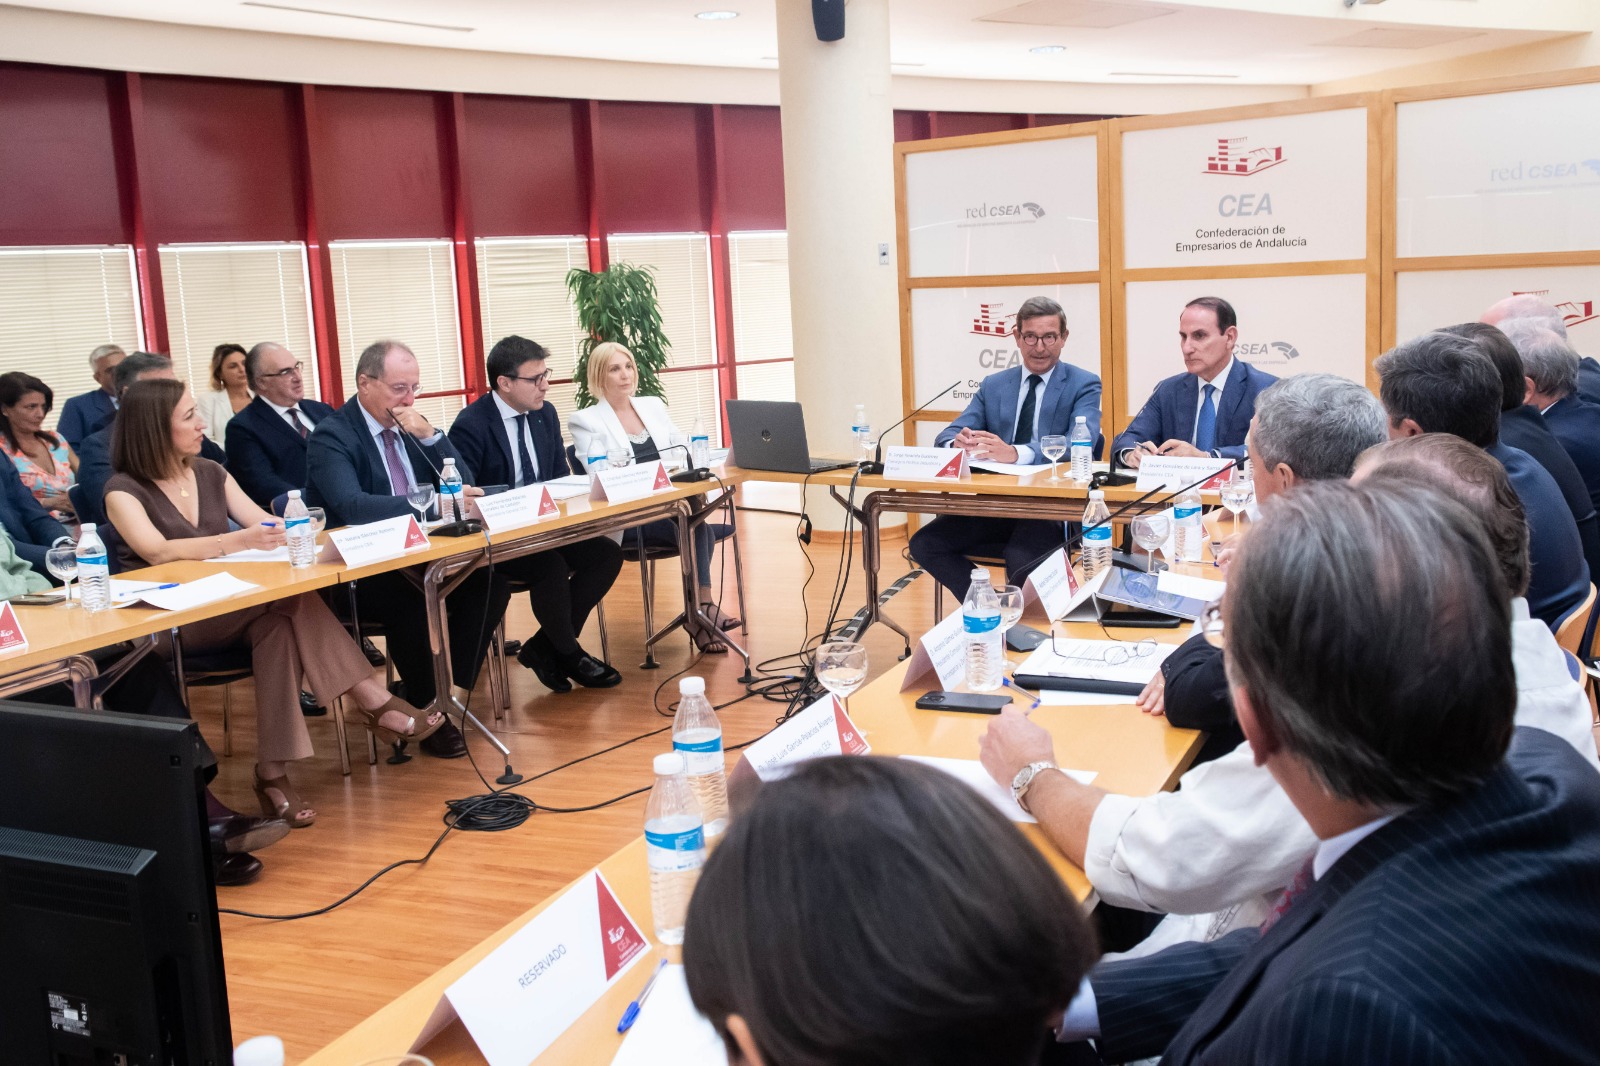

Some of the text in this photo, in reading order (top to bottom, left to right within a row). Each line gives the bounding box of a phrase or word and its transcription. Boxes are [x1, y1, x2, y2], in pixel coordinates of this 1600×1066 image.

[1490, 160, 1577, 181] red CSEA
[966, 203, 1021, 218] red CSEA
[1218, 193, 1273, 217] CEA
[1195, 225, 1285, 239] Confederación de
[1175, 236, 1307, 253] Empresarios de Andalucía
[1233, 343, 1268, 355] CSEA
[979, 349, 1020, 368] CEA
[765, 755, 777, 767] José
[776, 749, 788, 761] Luis
[617, 936, 632, 952] CEA
[518, 943, 567, 989] RESERVADO
